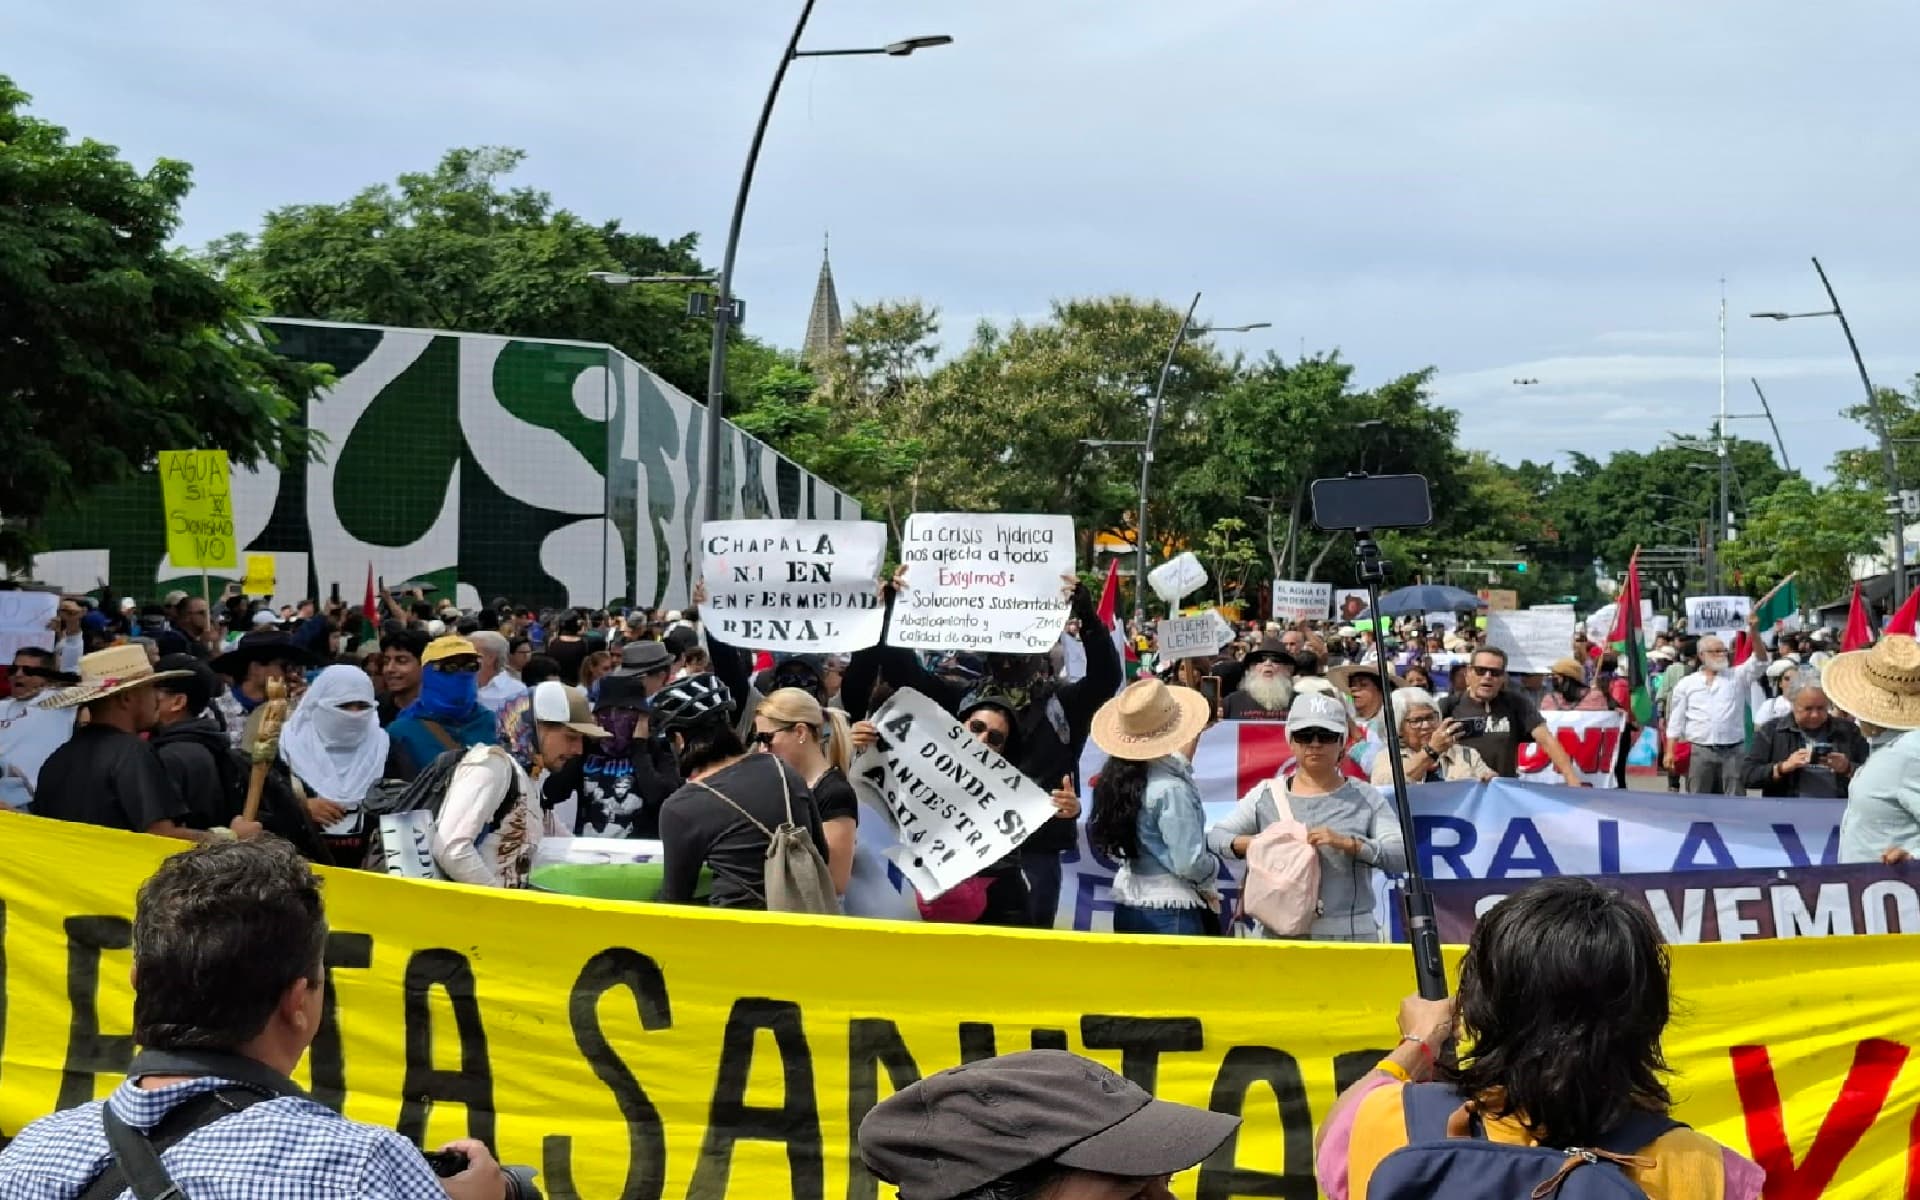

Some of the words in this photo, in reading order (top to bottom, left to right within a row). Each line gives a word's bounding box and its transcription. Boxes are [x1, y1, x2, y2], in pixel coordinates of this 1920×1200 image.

[168, 453, 224, 485] AGUA
[910, 519, 933, 542] La
[195, 536, 226, 560] NO
[708, 533, 836, 556] CHAPALA
[905, 549, 928, 561] nos
[932, 549, 981, 564] afecta
[988, 550, 999, 561] a
[1003, 545, 1049, 563] todxs
[786, 561, 834, 583] EN
[712, 591, 879, 610] ENFERMEDAD
[912, 590, 985, 610] Soluciones
[723, 619, 840, 641] RENAL
[884, 713, 914, 742] A
[920, 742, 997, 810] DONDE
[948, 725, 1022, 792] SIAPA
[1771, 823, 1841, 867] V
[1728, 1038, 1920, 1200] V
